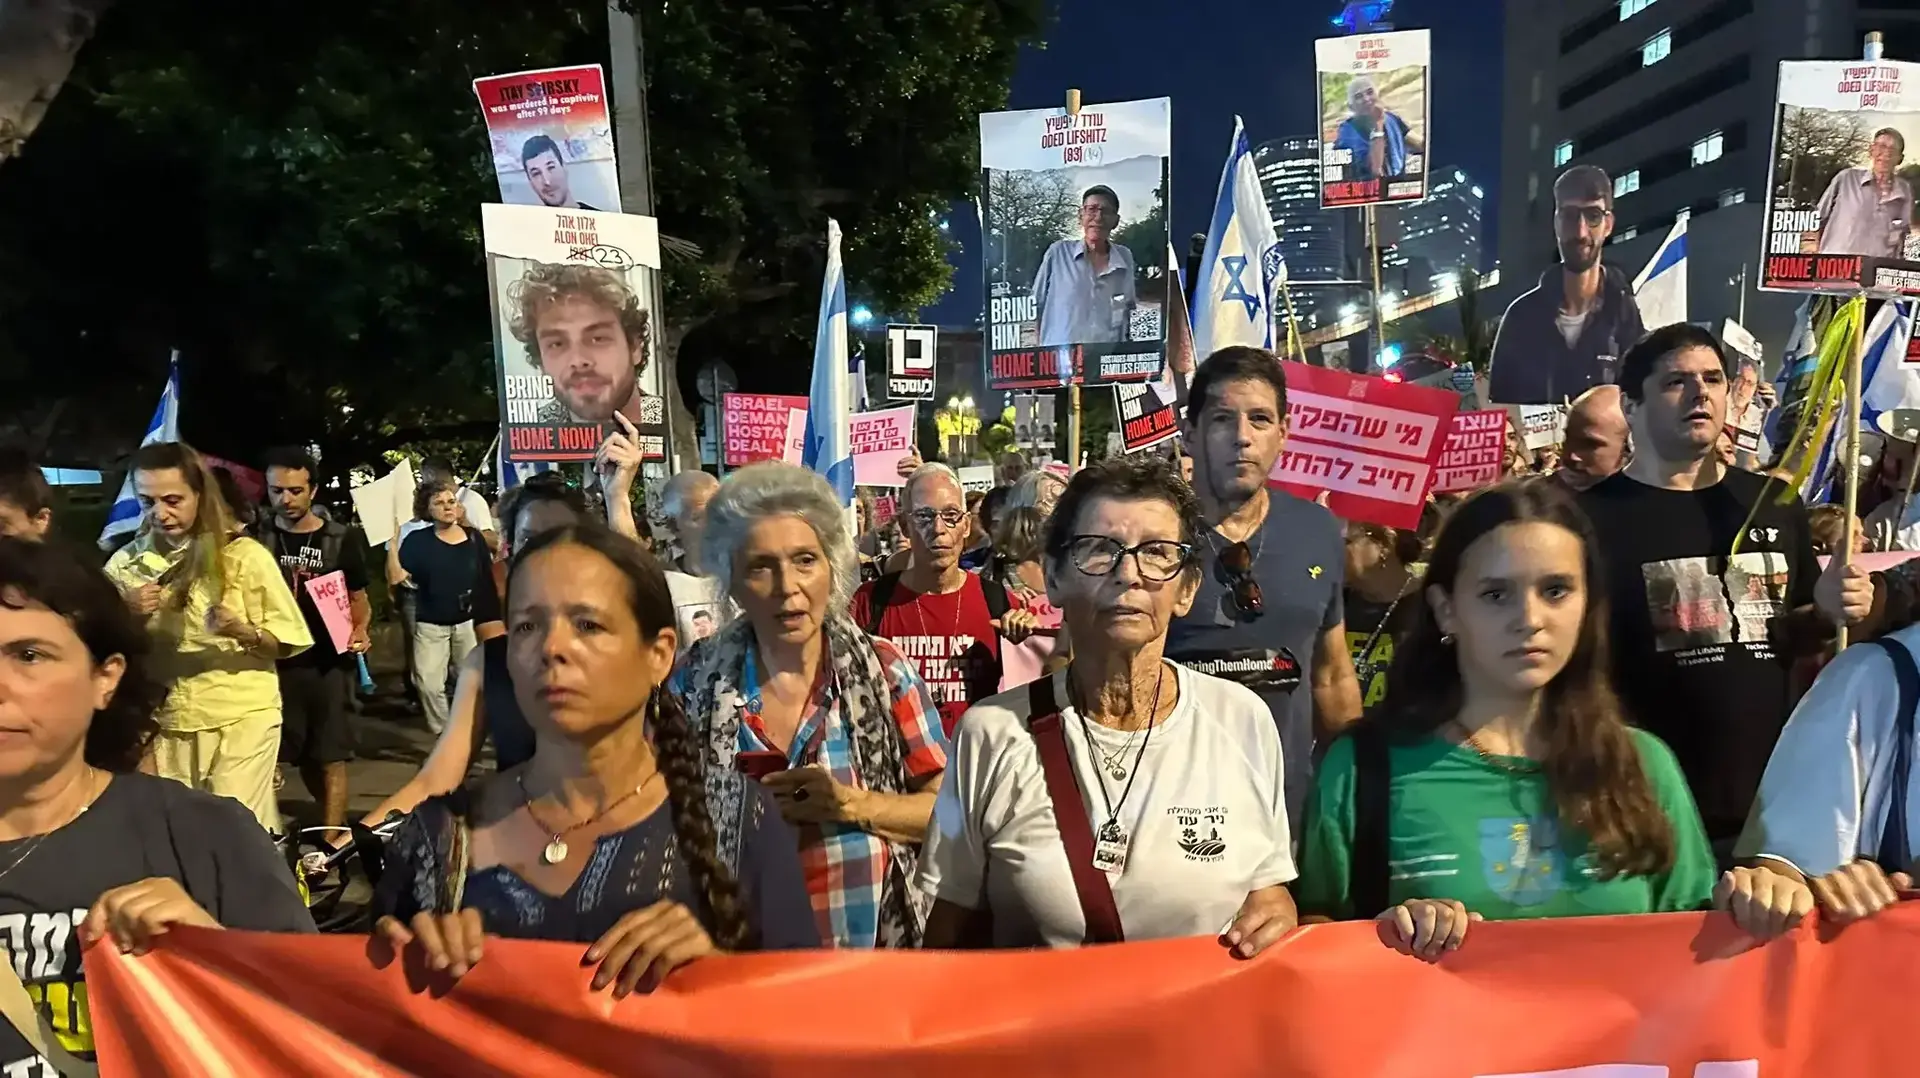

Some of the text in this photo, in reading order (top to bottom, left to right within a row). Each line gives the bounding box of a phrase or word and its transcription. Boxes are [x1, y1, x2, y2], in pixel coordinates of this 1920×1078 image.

[490, 94, 600, 114] was murdered in captivity
[516, 104, 572, 120] after 99 days
[1042, 128, 1107, 149] ODED LIFSHITZ
[556, 214, 596, 230] אלון אהל
[1772, 210, 1820, 231] BRING
[554, 230, 599, 246] ALON OHEL
[1770, 232, 1801, 254] HIM
[596, 248, 624, 265] 23
[1768, 256, 1863, 280] HOME NOW!
[991, 295, 1037, 324] BRING
[991, 323, 1020, 350] HIM
[992, 351, 1035, 378] HOME
[1100, 362, 1133, 376] FAMILIES
[505, 374, 554, 399] BRING
[1118, 383, 1148, 401] BRING
[508, 399, 538, 423] HIM
[726, 396, 789, 412] ISRAEL
[1122, 398, 1143, 420] HIM
[728, 411, 788, 426] DEMAN
[1126, 404, 1176, 440] HOME NOW!
[509, 424, 603, 450] HOME NOW!
[728, 424, 787, 440] HOSTA
[1395, 423, 1423, 446] מי
[730, 439, 772, 453] DEAL
[1280, 450, 1354, 480] להחז
[1358, 465, 1415, 492] חייב
[1204, 815, 1224, 824] ניר
